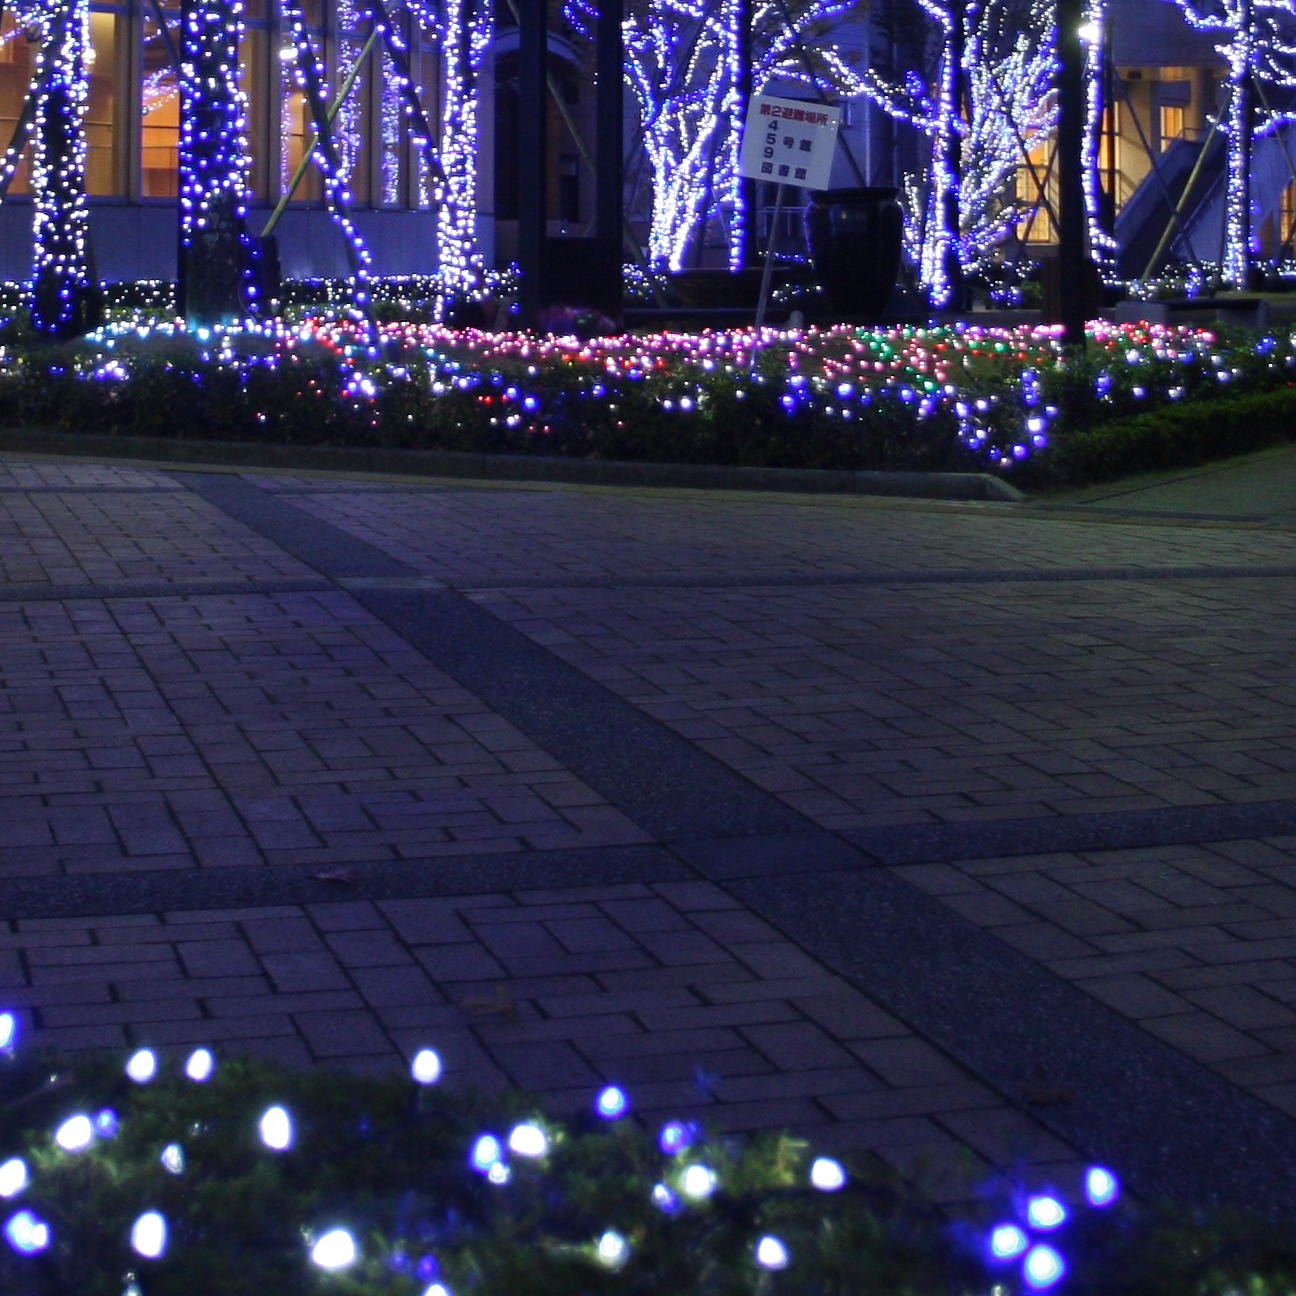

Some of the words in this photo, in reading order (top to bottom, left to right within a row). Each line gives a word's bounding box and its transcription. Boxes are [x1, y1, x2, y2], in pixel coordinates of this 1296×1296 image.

[759, 103, 829, 126] 第2避難場所
[767, 120, 778, 131] 4
[763, 146, 774, 159] 9
[760, 161, 807, 181] 図書館
